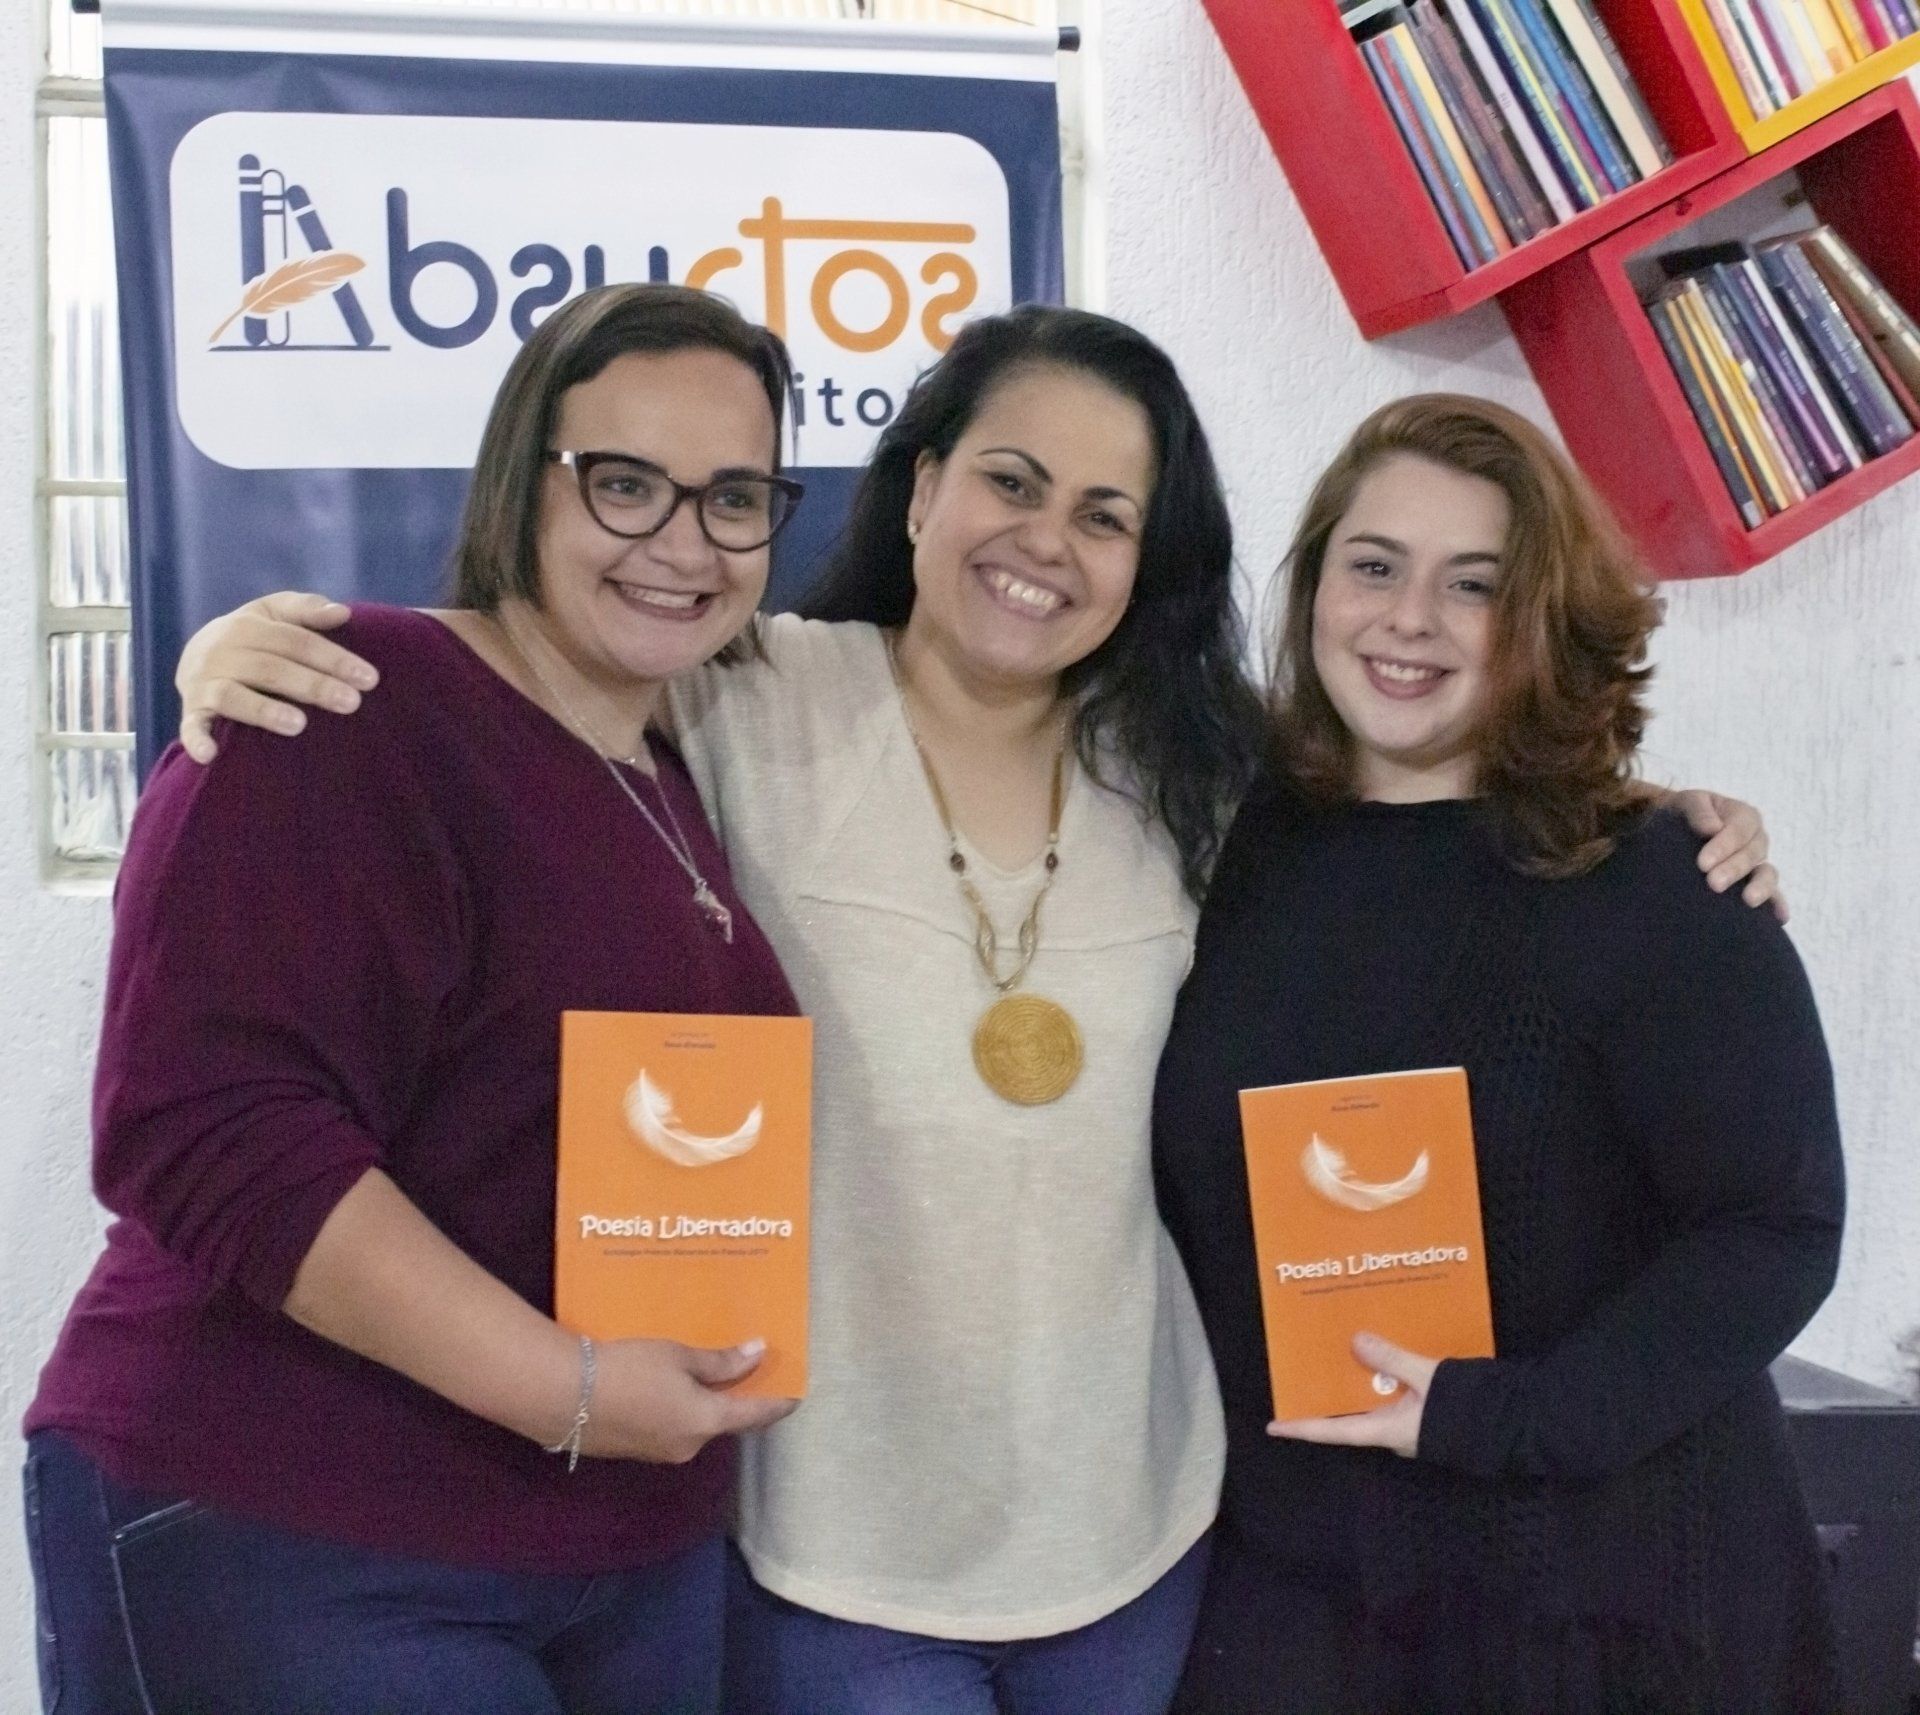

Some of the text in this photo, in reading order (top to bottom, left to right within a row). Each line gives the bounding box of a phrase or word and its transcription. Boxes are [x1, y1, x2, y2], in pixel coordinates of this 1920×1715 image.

[580, 1214, 792, 1239] Poesia Libertadora
[1276, 1246, 1468, 1284] Poesia Libertadora
